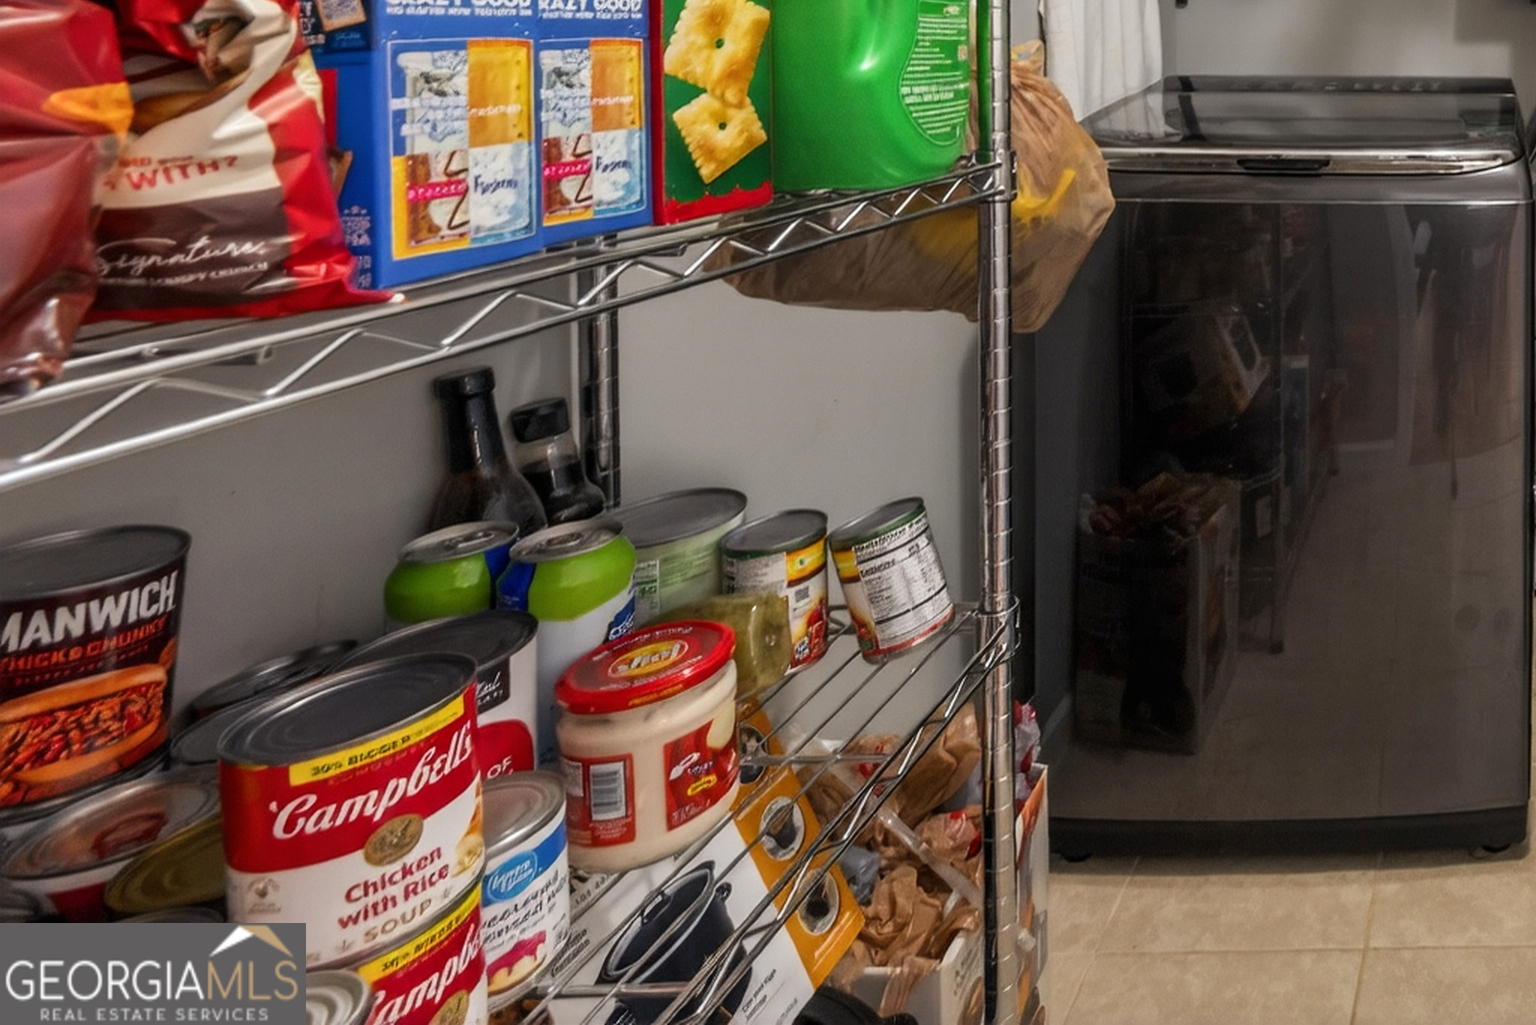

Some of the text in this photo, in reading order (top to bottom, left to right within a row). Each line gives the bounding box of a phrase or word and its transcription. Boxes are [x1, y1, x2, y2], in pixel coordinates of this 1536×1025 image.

[268, 719, 473, 841] Campbell's
[337, 863, 450, 930] with Rice
[344, 846, 442, 905] Chicken
[363, 898, 433, 942] SOUP
